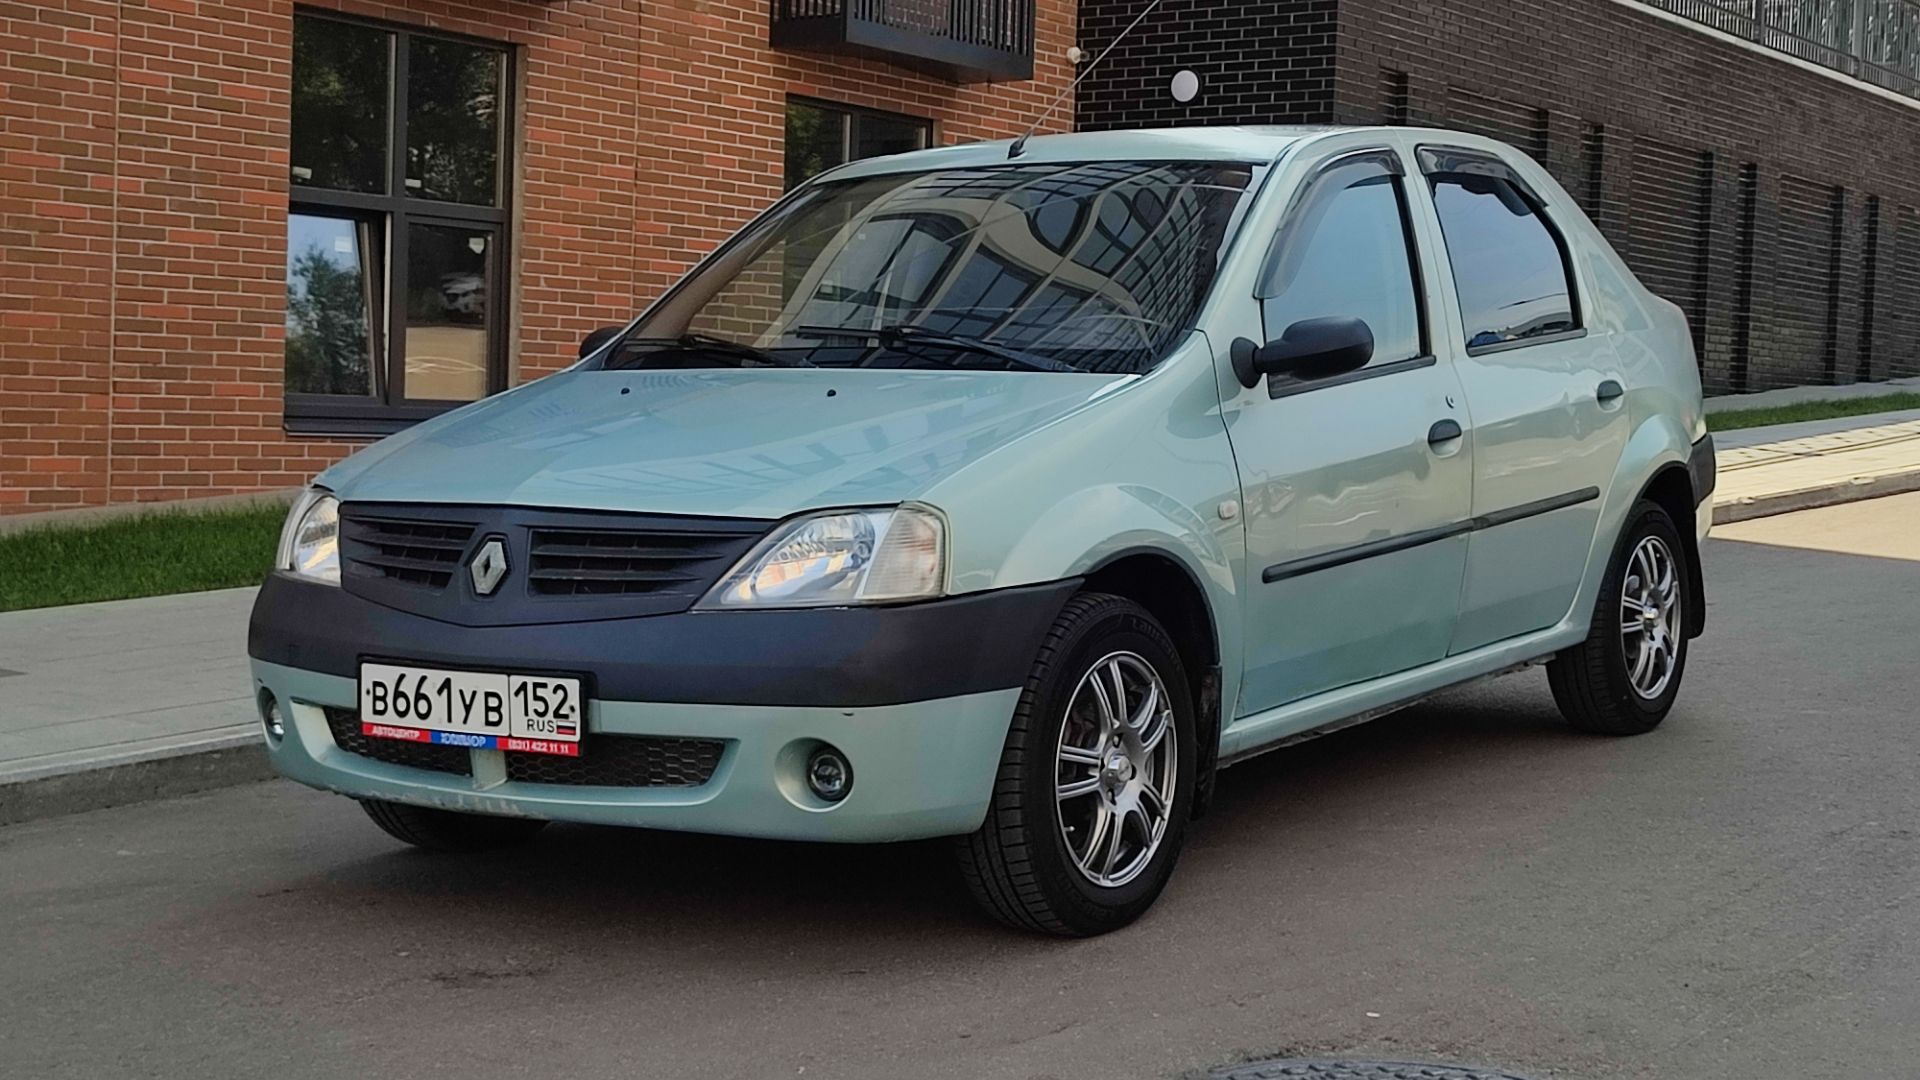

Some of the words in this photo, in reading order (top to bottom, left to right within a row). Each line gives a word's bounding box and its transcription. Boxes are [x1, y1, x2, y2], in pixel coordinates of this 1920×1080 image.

[372, 673, 503, 727] В661УВ
[513, 680, 569, 720] 152
[526, 718, 555, 733] RUS
